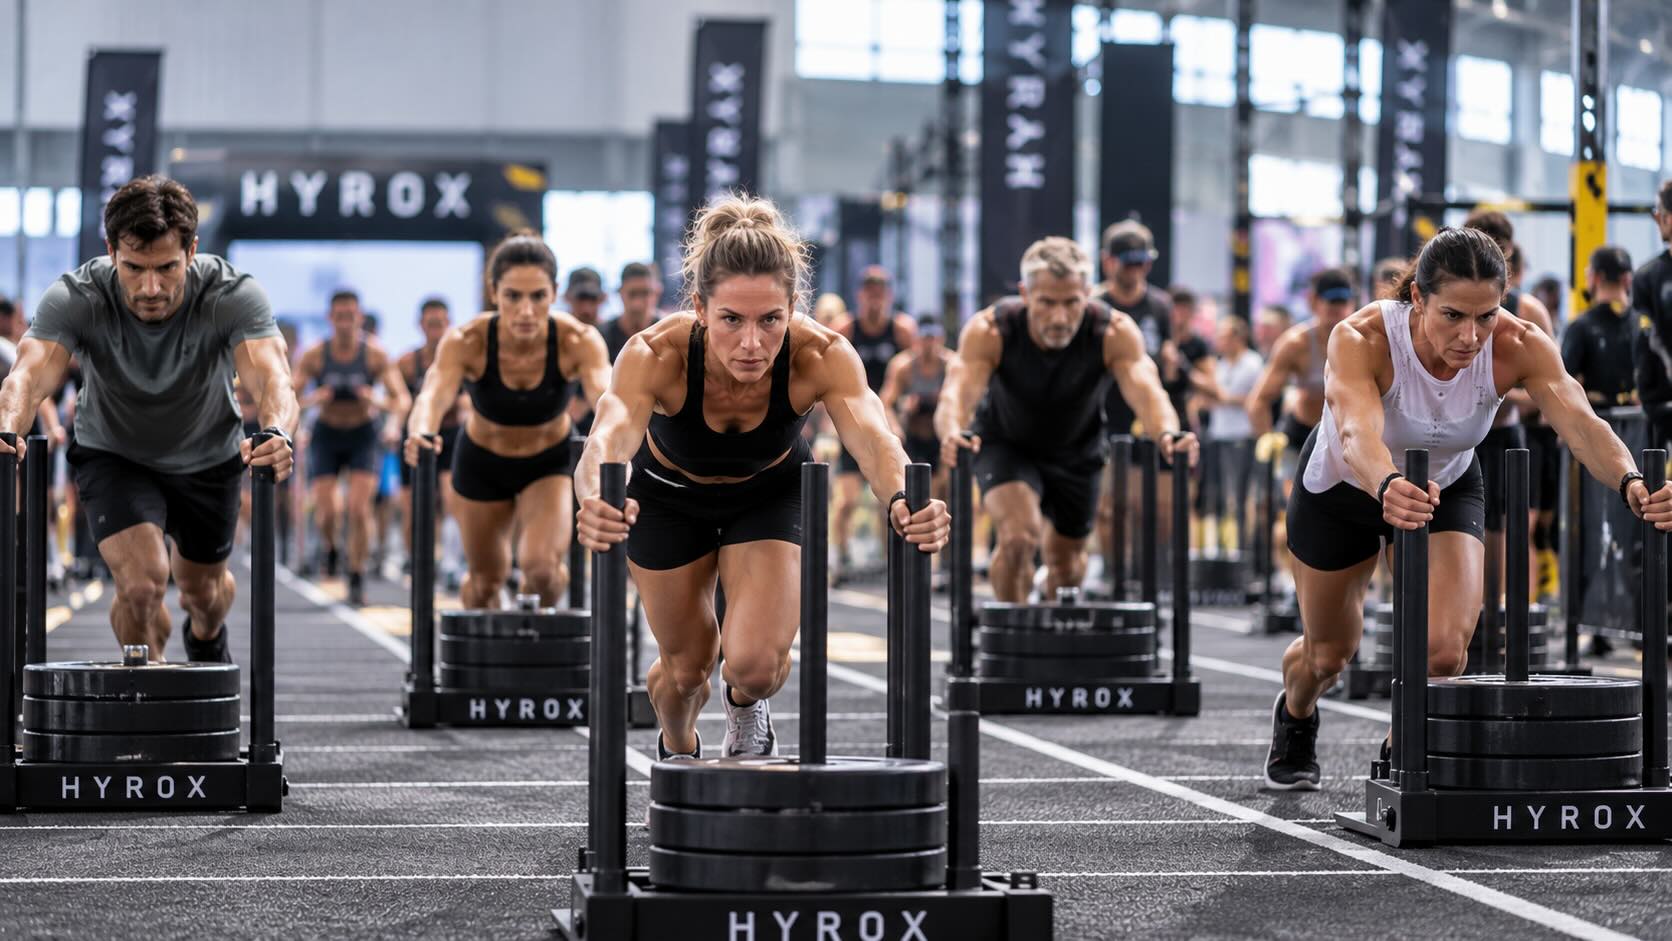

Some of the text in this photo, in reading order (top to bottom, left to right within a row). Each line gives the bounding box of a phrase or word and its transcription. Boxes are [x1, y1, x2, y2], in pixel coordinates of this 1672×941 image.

[241, 170, 472, 219] HYROX
[469, 698, 584, 720] HYROX
[1025, 687, 1134, 709] HYROX
[61, 776, 206, 799] HYROX
[1493, 804, 1646, 830] HYROX
[728, 910, 928, 941] HYROX
